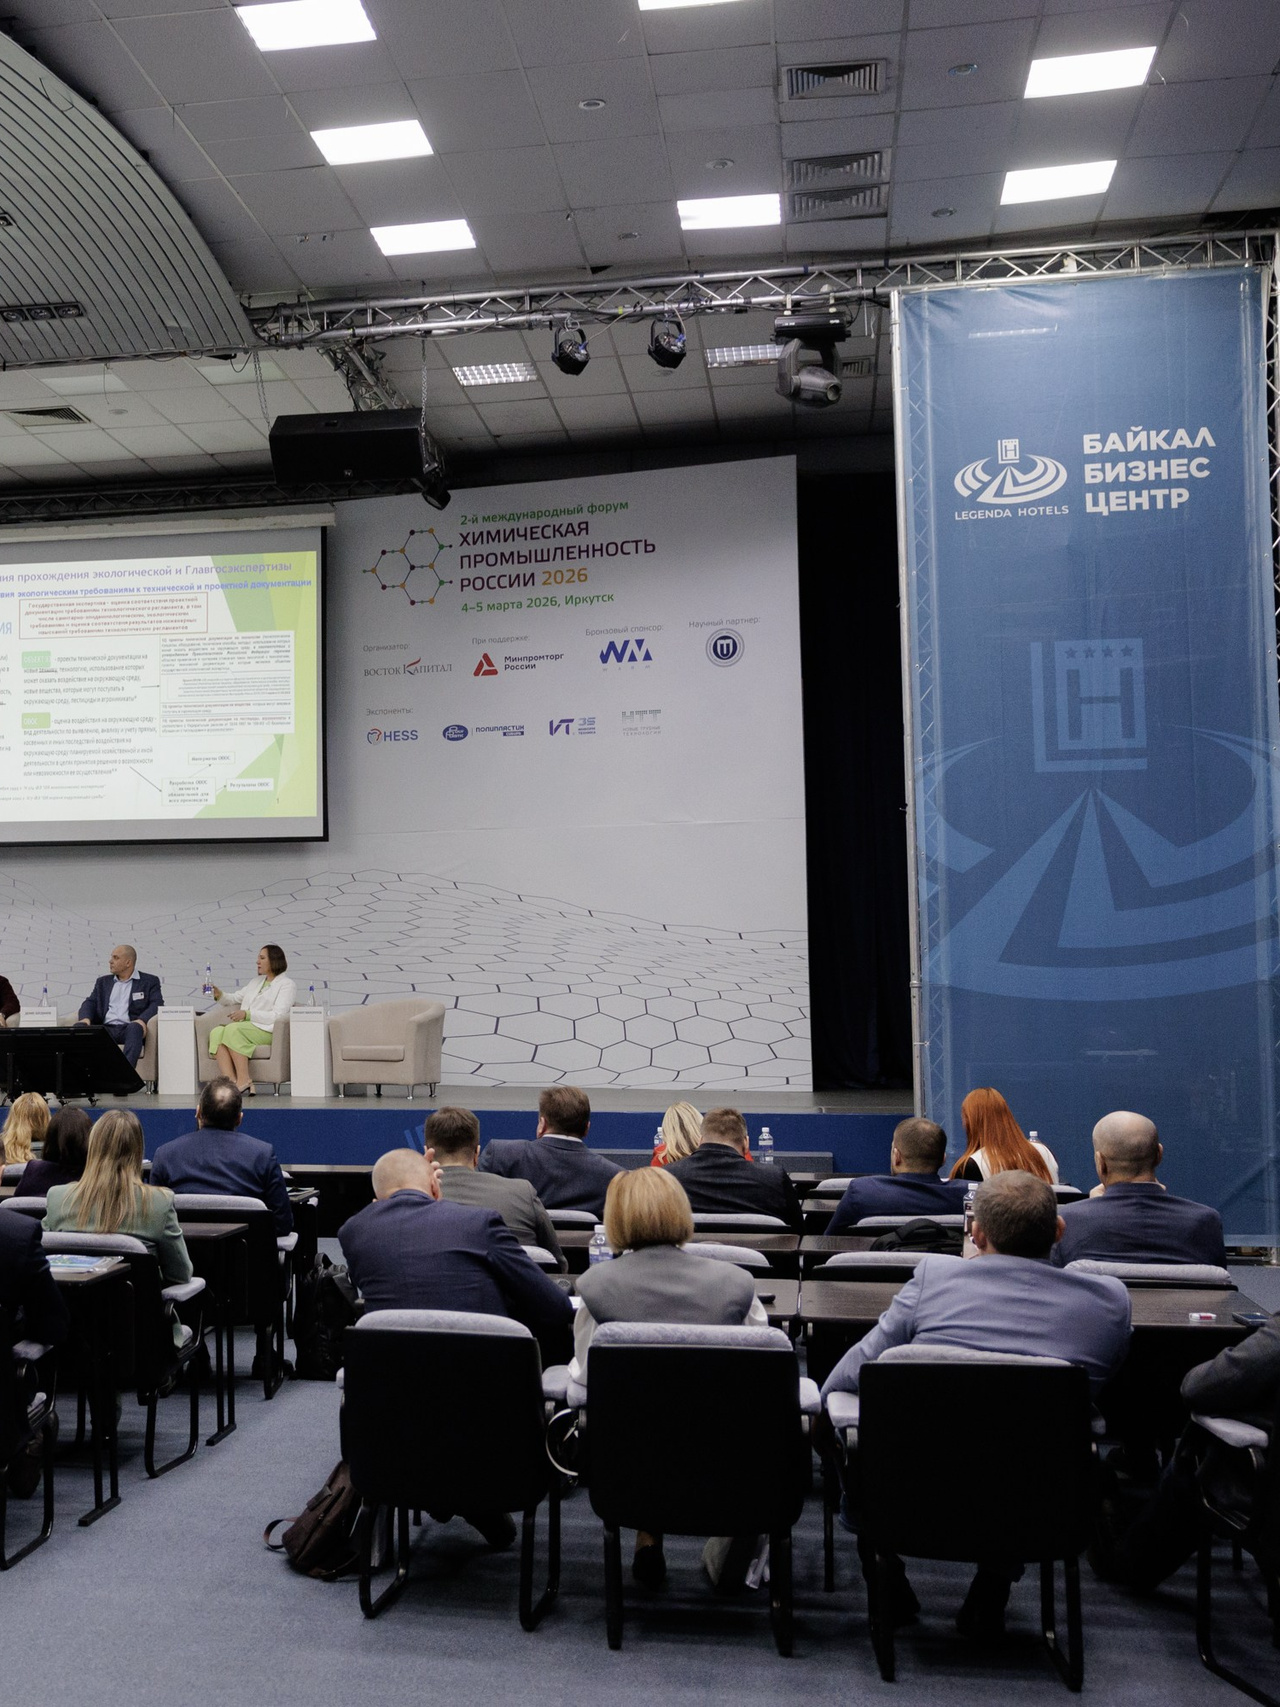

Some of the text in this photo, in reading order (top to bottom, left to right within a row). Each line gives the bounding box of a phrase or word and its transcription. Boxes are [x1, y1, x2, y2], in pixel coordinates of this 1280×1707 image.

[1083, 426, 1216, 454] БАЙКАЛ
[1084, 457, 1210, 484] БИЗНЕС
[1085, 488, 1190, 516] ЦЕНТР
[460, 501, 629, 525] 2-й международный форум
[955, 505, 1069, 521] LEGENDA HOTELS
[459, 521, 589, 547] ХИМИЧЕСКАЯ
[460, 539, 656, 569] ПРОМЫШЛЕННОСТЬ
[17, 571, 89, 584] прохождения
[92, 565, 172, 580] экологической
[185, 562, 292, 576] Главгосэкспертизы
[460, 568, 588, 592] РОССИИ 2026
[17, 589, 78, 598] экологическим
[80, 585, 135, 597] требованиям
[143, 583, 194, 593] технической
[204, 581, 248, 592] проектной
[250, 578, 311, 590] документации
[487, 601, 522, 612] марта
[526, 597, 561, 608] 2026,
[564, 593, 614, 607] Иркутск
[585, 624, 664, 636] Бронзовый спонсор:
[689, 616, 761, 629] Научный партнер:
[363, 643, 410, 652] Организатор:
[472, 635, 530, 645] При поддержке:
[364, 657, 452, 677] ВОСТОК КАПИТАЛ
[504, 653, 564, 664] Минпромторг
[504, 663, 536, 671] России
[366, 707, 414, 716] Экспоненты:
[383, 730, 419, 742] HESS
